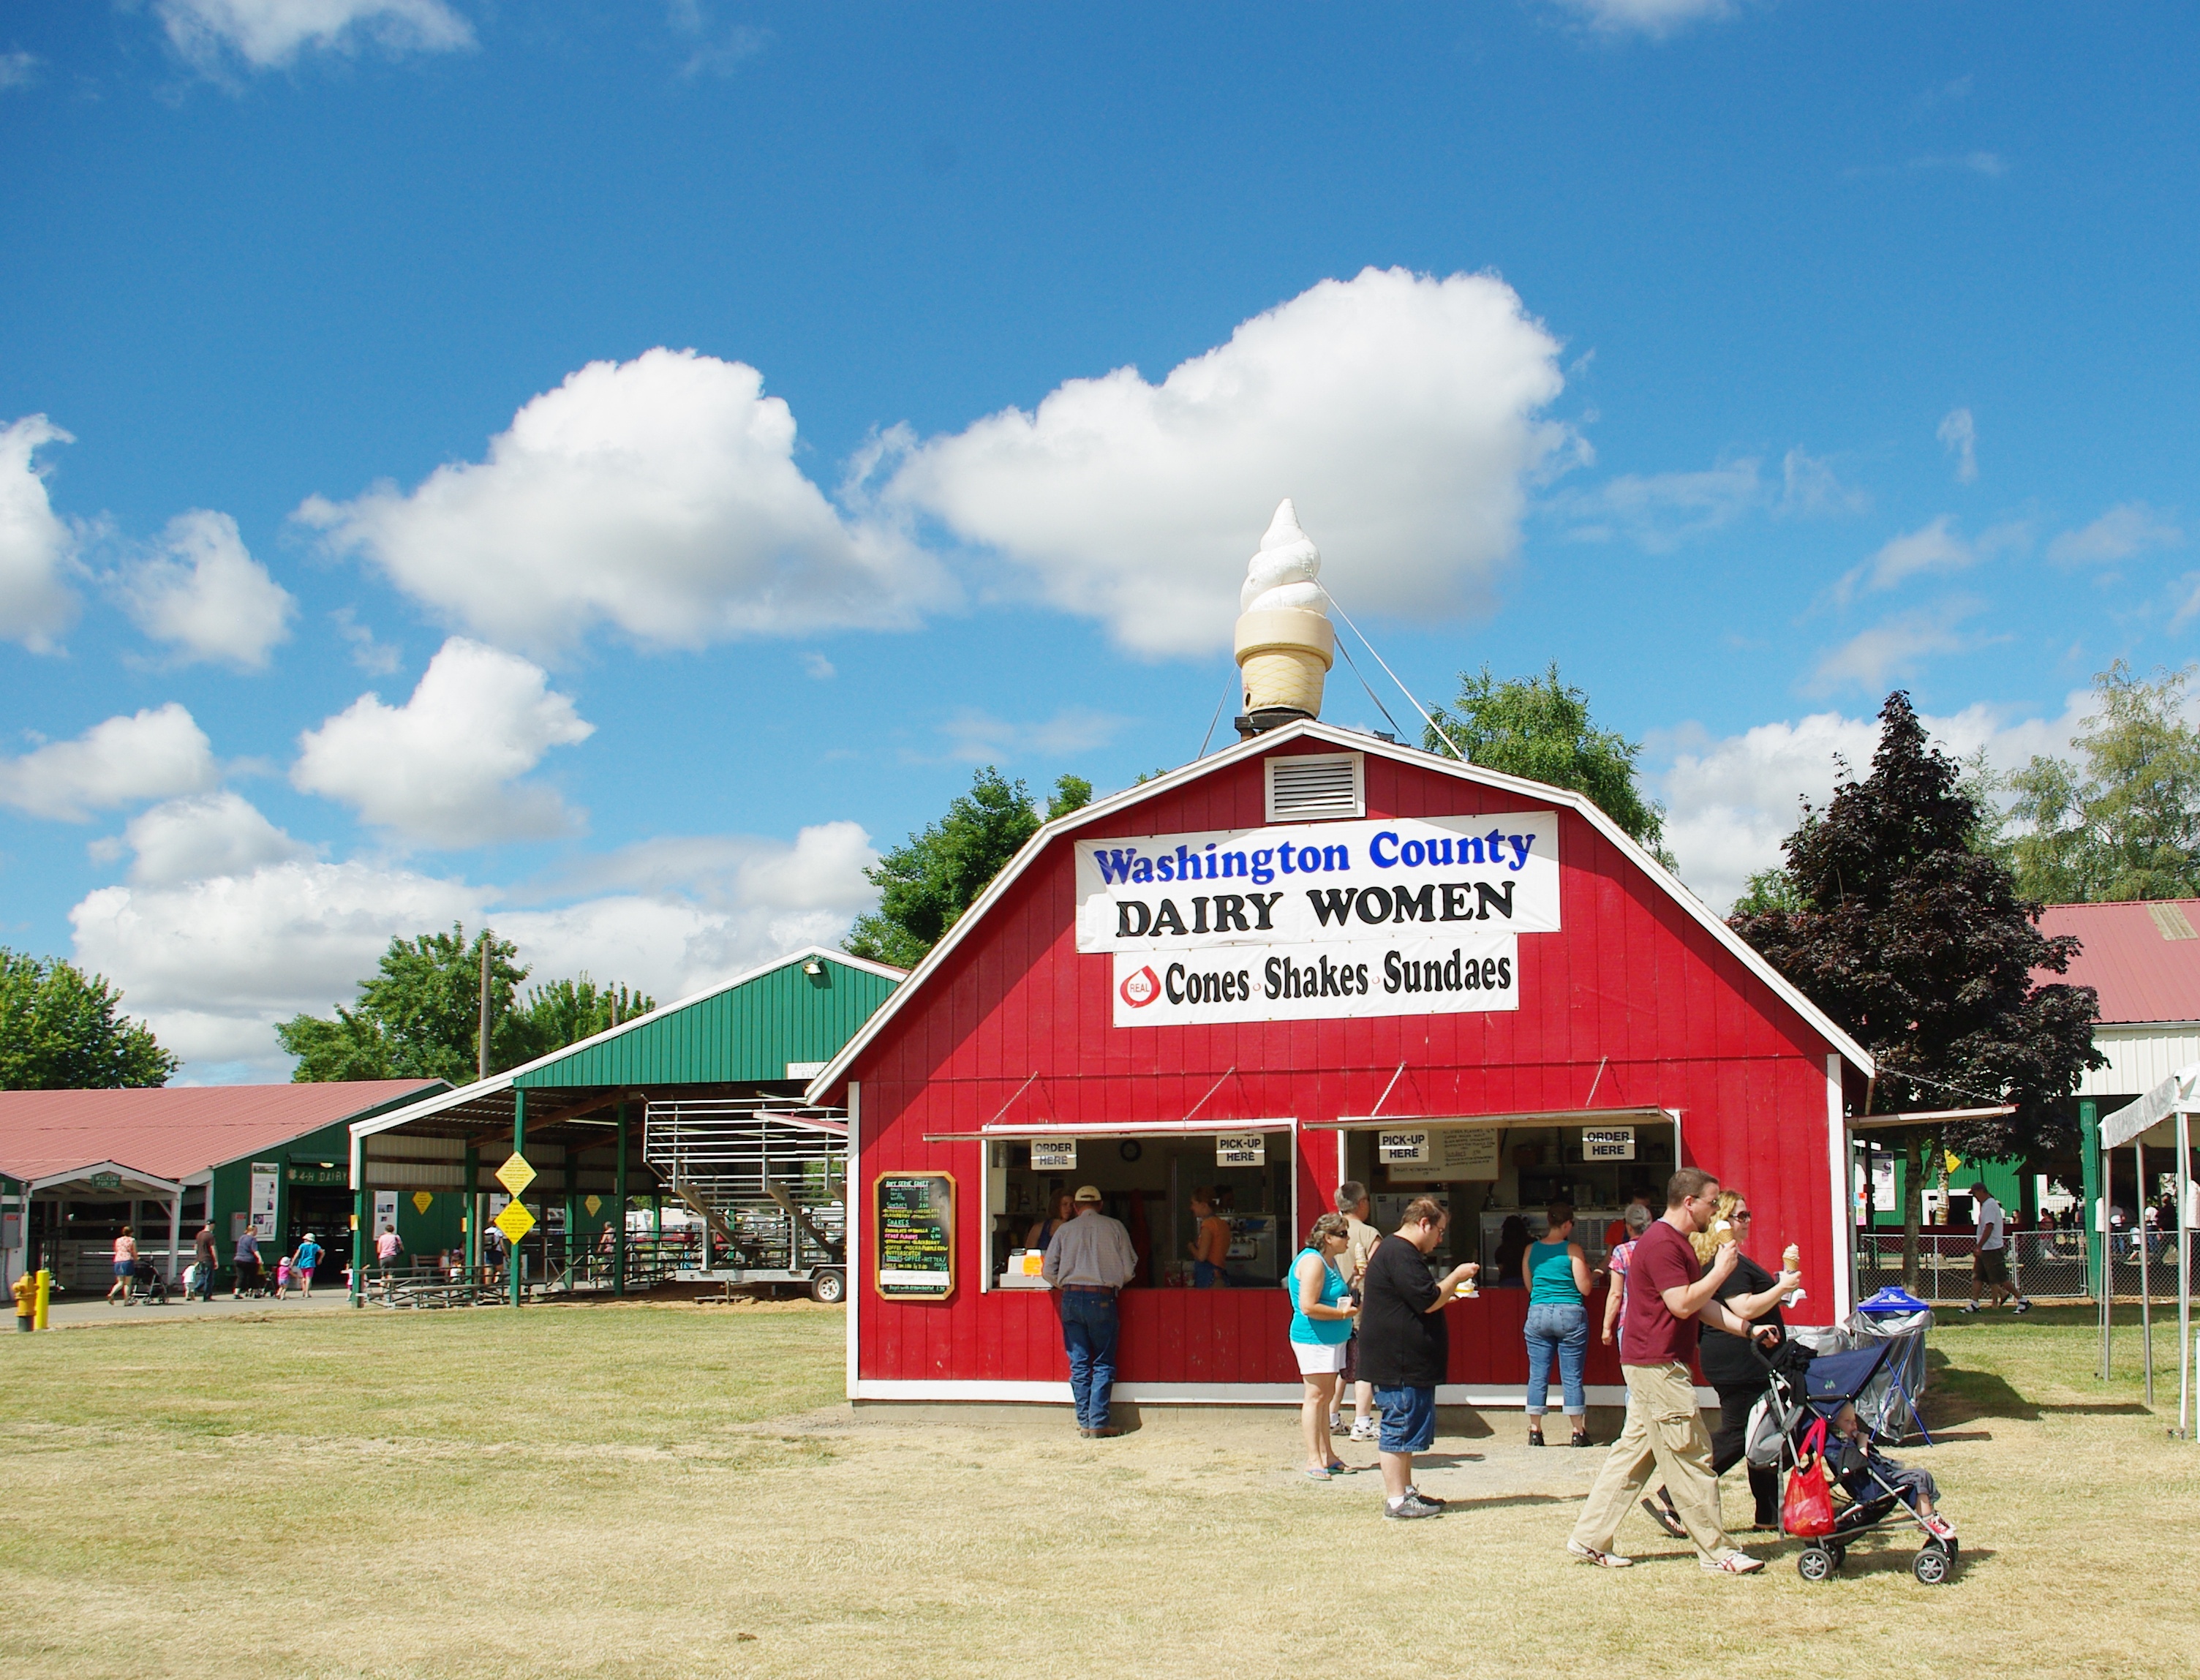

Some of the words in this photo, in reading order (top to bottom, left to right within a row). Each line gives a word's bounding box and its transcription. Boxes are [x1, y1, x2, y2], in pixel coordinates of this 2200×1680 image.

[1094, 840, 1350, 886] Washington
[1369, 827, 1536, 870] County
[1115, 892, 1284, 938] DAIRY
[1306, 881, 1515, 927] WOMEN
[1165, 961, 1249, 1005] Cones
[1263, 956, 1369, 1000] Shakes
[1383, 949, 1512, 994] Sundaes
[1130, 983, 1150, 992] REAL
[1382, 1134, 1425, 1145] PICK-UP
[1587, 1131, 1630, 1142] ORDER
[1035, 1142, 1072, 1153] ORDER
[1220, 1138, 1261, 1148] PICK-UP
[1390, 1148, 1419, 1159] HERE
[1592, 1145, 1624, 1155] HERE
[1039, 1156, 1068, 1165] HERE
[1227, 1152, 1255, 1161] HERE
[299, 1172, 314, 1182] 4-H
[319, 1171, 347, 1182] DAIRY
